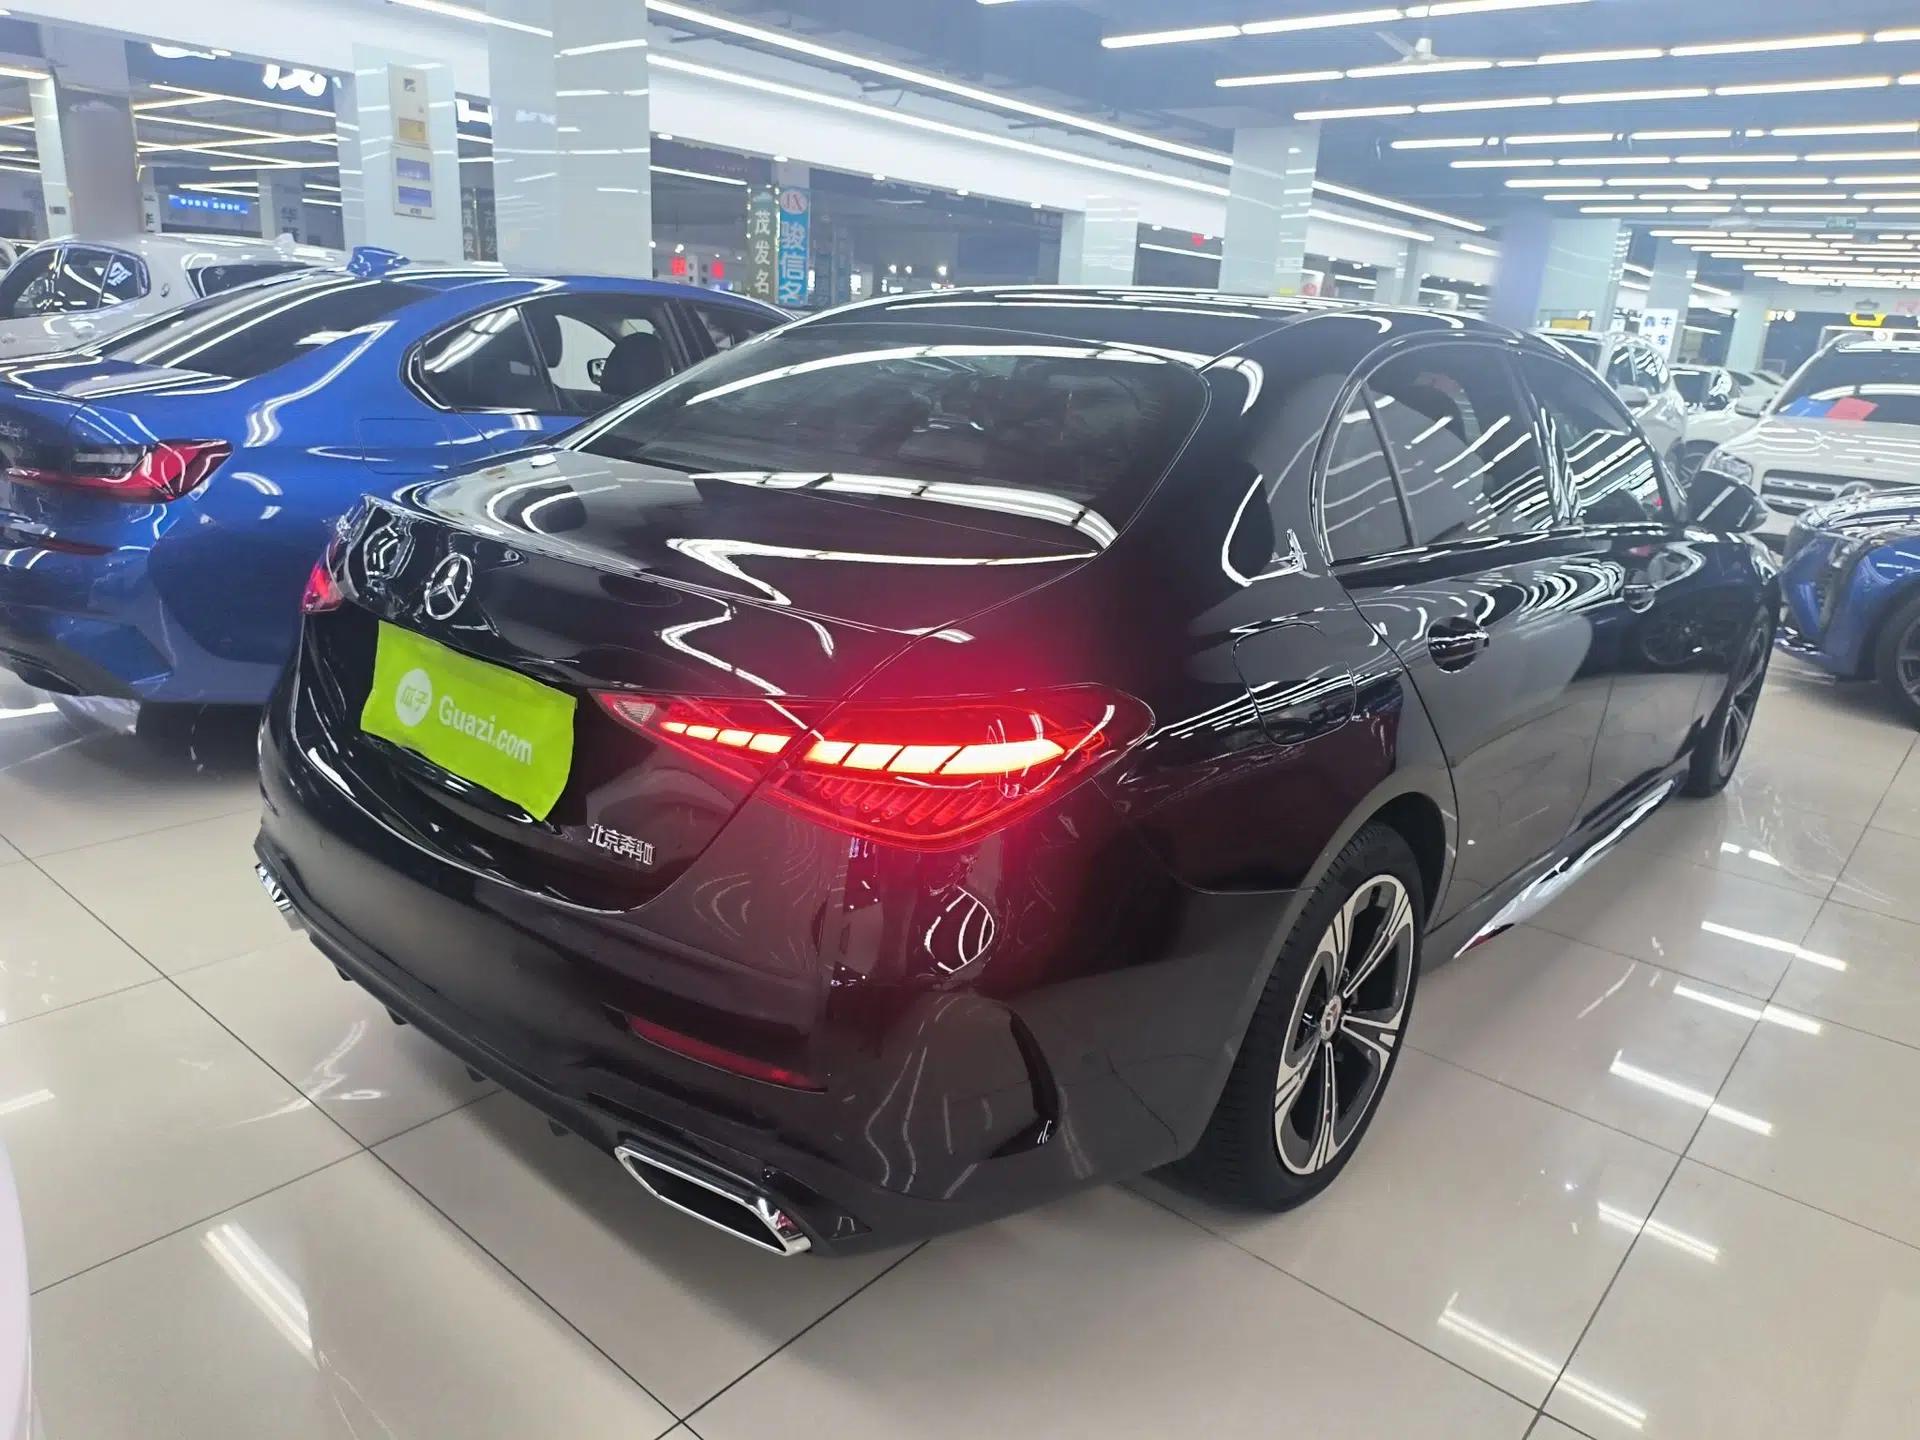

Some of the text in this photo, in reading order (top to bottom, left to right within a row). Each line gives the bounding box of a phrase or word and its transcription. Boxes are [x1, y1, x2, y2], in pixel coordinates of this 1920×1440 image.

[754, 210, 771, 294] 茂发名
[401, 686, 428, 711] 瓜子
[439, 695, 533, 765] Guazi.com
[588, 823, 655, 865] 北京奔驰
